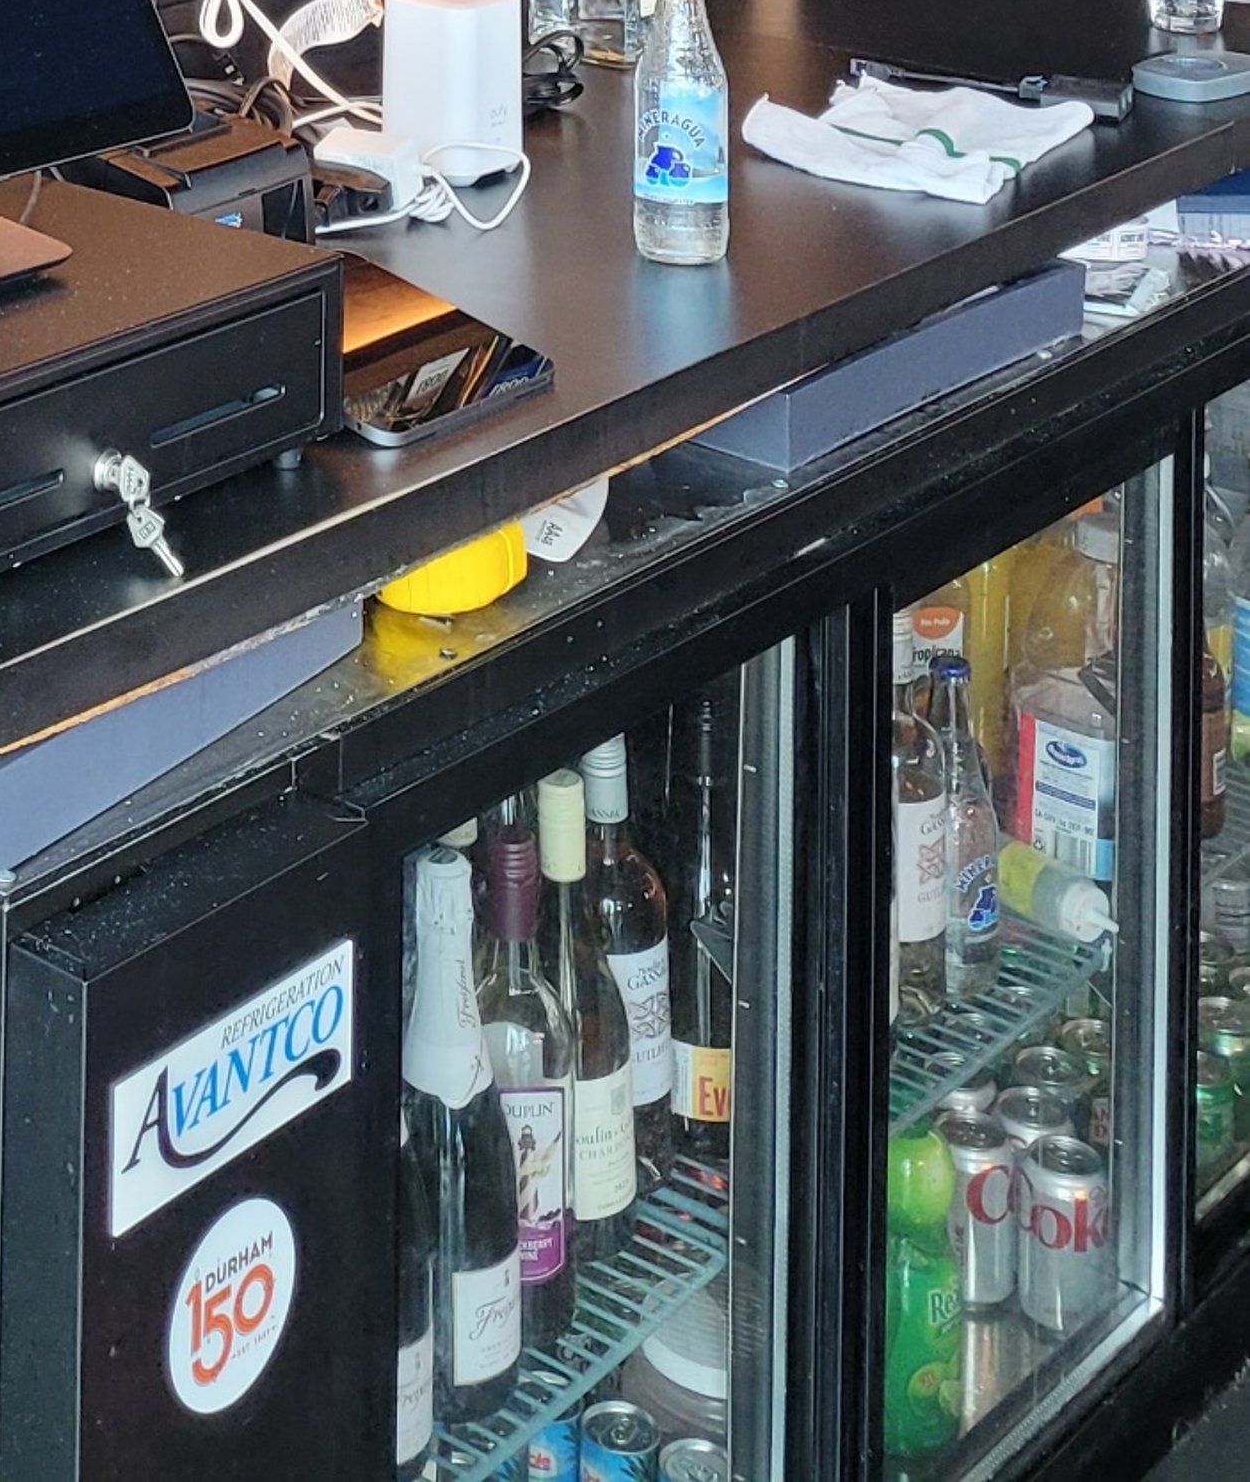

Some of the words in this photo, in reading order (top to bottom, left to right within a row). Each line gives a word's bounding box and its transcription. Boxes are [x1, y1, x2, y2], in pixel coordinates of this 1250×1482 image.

[636, 108, 705, 149] MINERAGUA
[221, 953, 345, 1050] REFRIGERATION
[121, 984, 345, 1175] AVANTCO
[700, 1075, 730, 1117] Ev
[206, 1230, 274, 1294] DURHAM
[185, 1263, 275, 1387] 150
